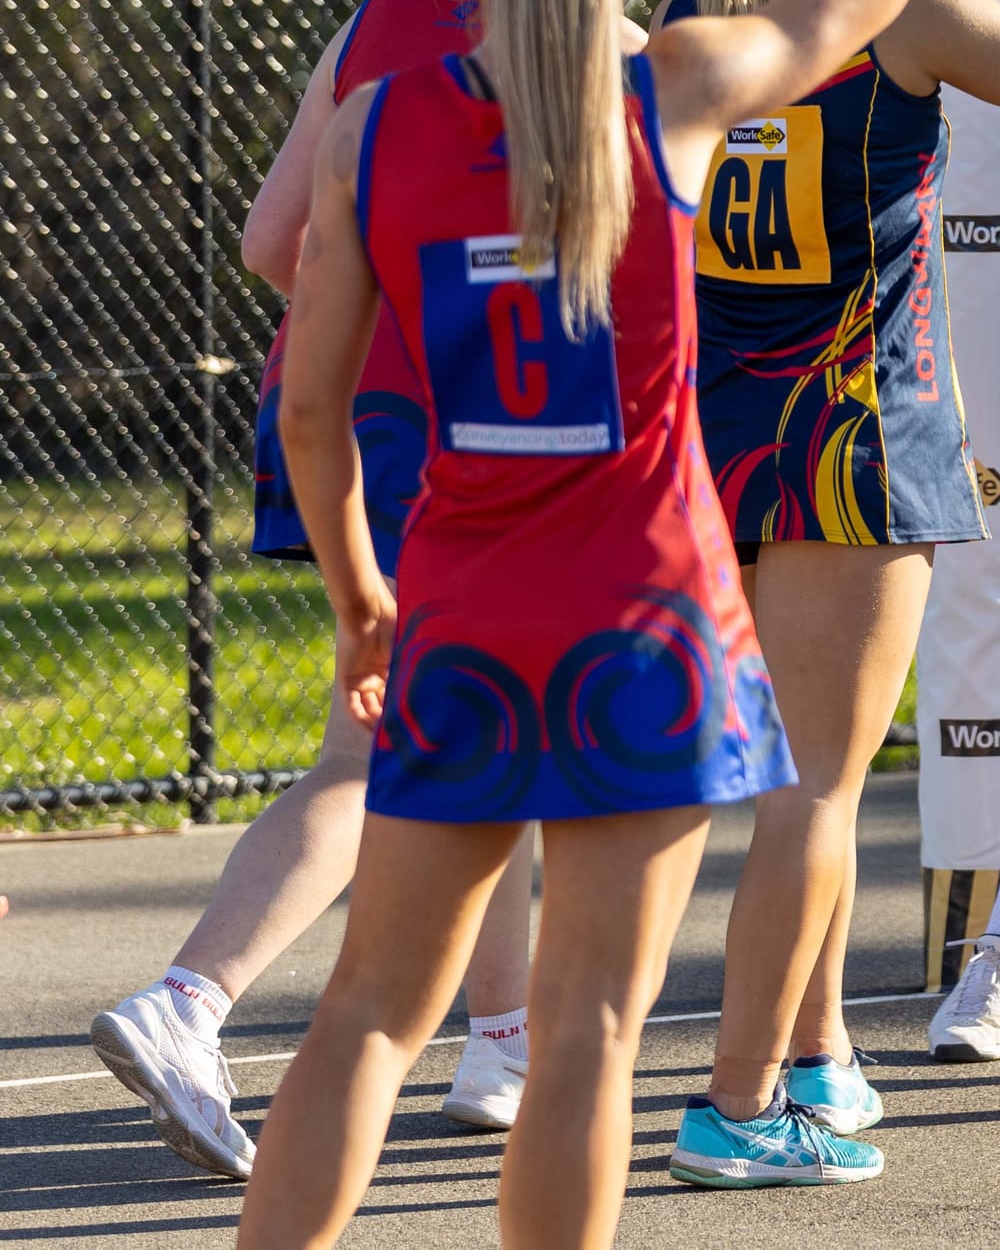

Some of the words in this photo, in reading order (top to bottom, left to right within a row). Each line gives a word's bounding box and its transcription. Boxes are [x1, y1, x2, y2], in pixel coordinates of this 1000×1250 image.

[708, 157, 801, 271] GA
[486, 281, 550, 420] C
[163, 976, 200, 1000] BULN
